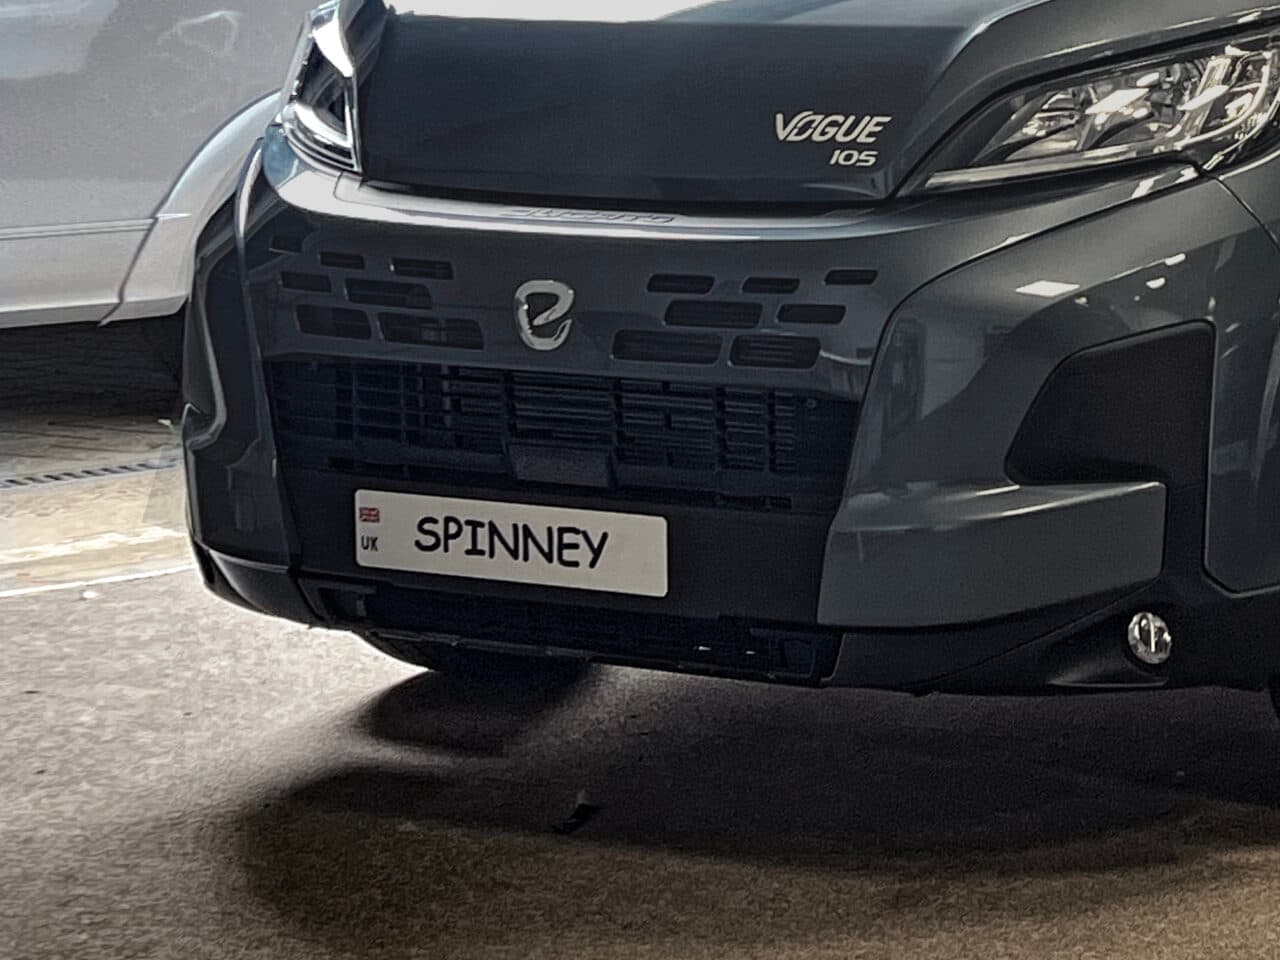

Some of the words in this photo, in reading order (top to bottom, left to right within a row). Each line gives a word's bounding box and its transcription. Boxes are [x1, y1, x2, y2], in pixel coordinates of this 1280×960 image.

[775, 110, 892, 143] VOGUE
[829, 148, 878, 166] 105
[360, 535, 378, 552] UK
[414, 515, 608, 569] SPINNEY
